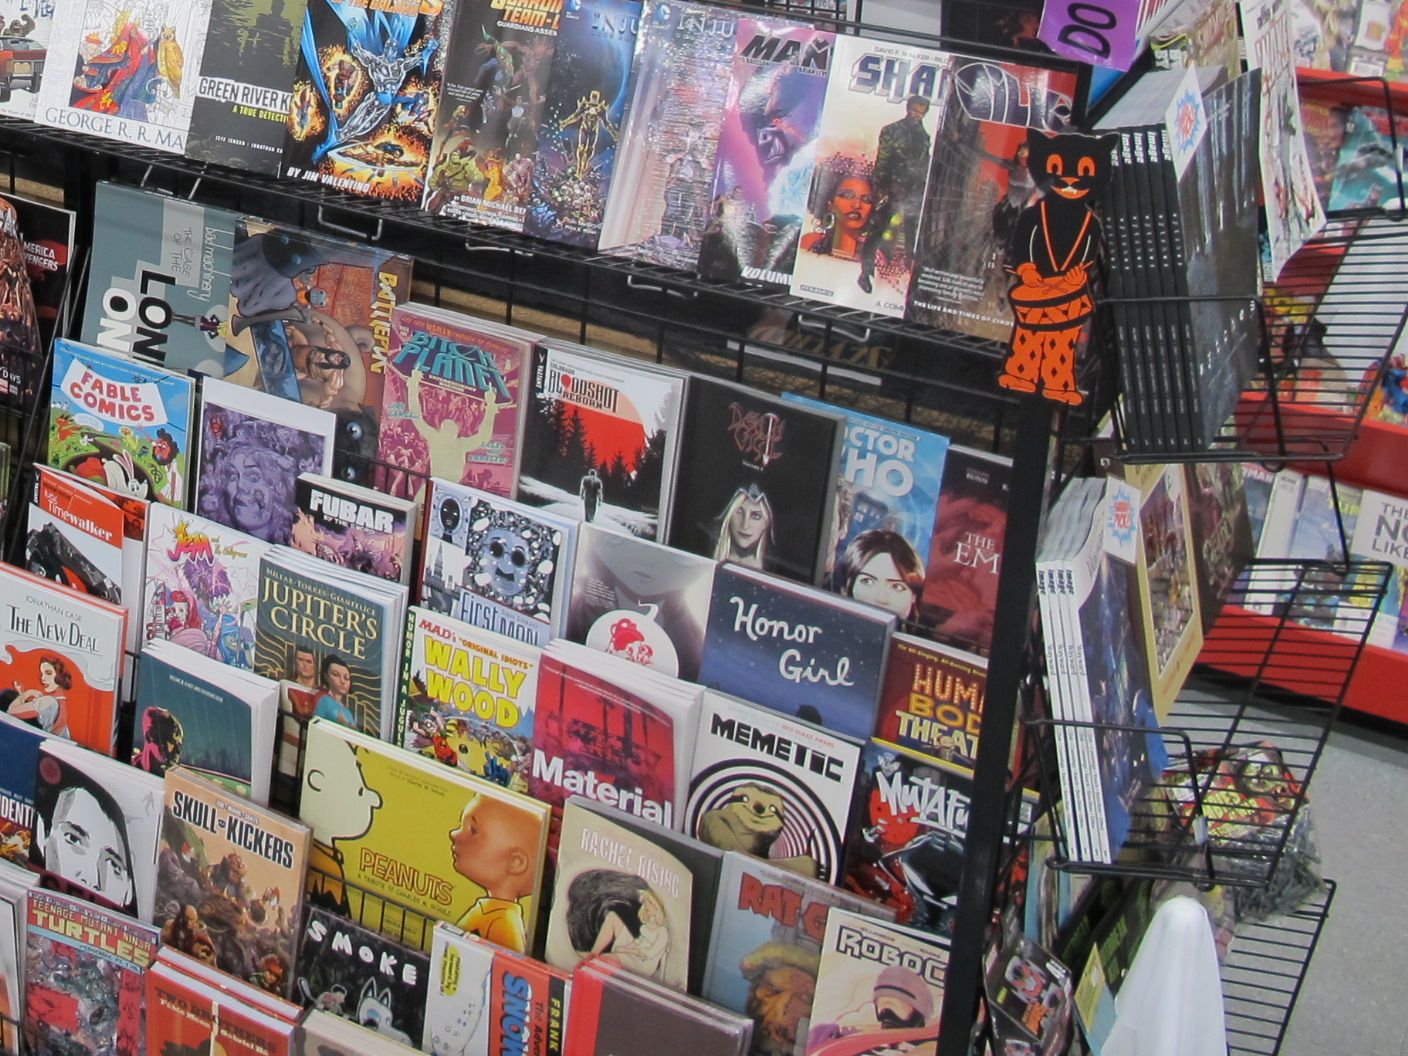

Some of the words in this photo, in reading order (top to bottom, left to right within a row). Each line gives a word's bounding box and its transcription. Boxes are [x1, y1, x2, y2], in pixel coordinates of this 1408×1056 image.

[1055, 2, 1118, 62] DO
[199, 77, 238, 102] GREEN
[242, 85, 278, 108] RIVER
[239, 107, 257, 118] TRUE
[45, 106, 113, 136] GEORGE
[118, 122, 133, 140] R.
[137, 126, 152, 143] R.
[1133, 132, 1145, 164] Image
[1146, 130, 1158, 164] Image
[286, 166, 299, 179] BY
[301, 169, 318, 184] JIM
[319, 172, 372, 195] VALENTINO
[69, 383, 155, 423] COMICS
[80, 370, 143, 404] FABLE
[547, 368, 621, 414] BLOODSHOT
[562, 391, 603, 410] REBORN
[47, 500, 114, 543] Timewalker
[309, 488, 394, 535] FUBAR
[964, 531, 995, 551] THE
[265, 566, 295, 585] MILLAR
[6, 603, 33, 636] THE
[35, 612, 67, 643] NEW
[69, 617, 100, 654] DEAL
[23, 594, 63, 616] JONATHAN
[63, 609, 83, 623] CASE
[261, 576, 380, 641] JUPITER'S
[269, 605, 367, 661] CIRCLE
[729, 595, 824, 645] Honor
[423, 634, 528, 700] WALLY
[778, 647, 856, 687] Girl
[425, 667, 521, 729] WOOD
[710, 712, 845, 783] MEMETIC
[532, 747, 674, 831] Material
[172, 790, 218, 834] SKULL
[225, 819, 295, 871] KICKERS
[358, 846, 454, 909] PEANUTS
[579, 827, 634, 873] RACHEL
[638, 851, 681, 899] RISING
[31, 897, 75, 922] TEENAGE
[80, 911, 121, 935] MUTANT
[123, 928, 152, 951] NINJA
[738, 871, 800, 929] RAT
[32, 908, 151, 967] TURTLES
[307, 919, 419, 987] SMOKE
[548, 996, 564, 1051] FRANK
